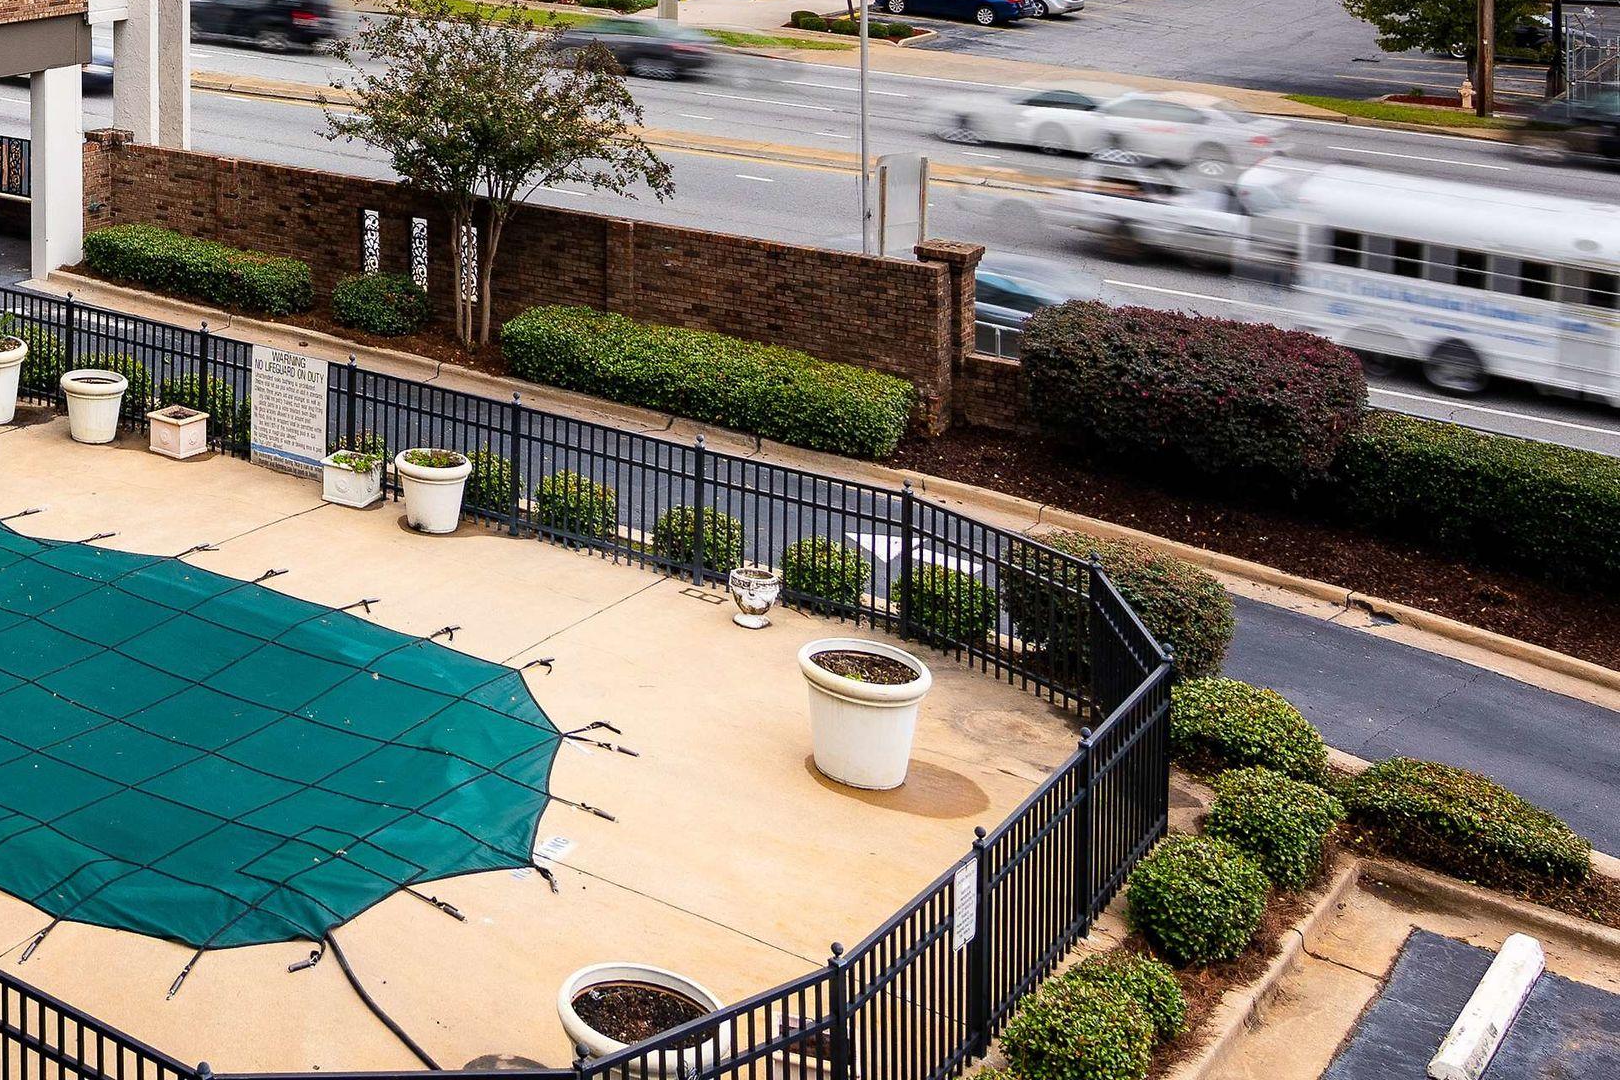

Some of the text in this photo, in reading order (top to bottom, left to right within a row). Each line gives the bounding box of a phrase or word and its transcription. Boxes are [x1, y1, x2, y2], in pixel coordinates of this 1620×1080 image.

[272, 351, 306, 368] WARNING
[255, 358, 324, 383] NO LIFEGUARD ON DUTY
